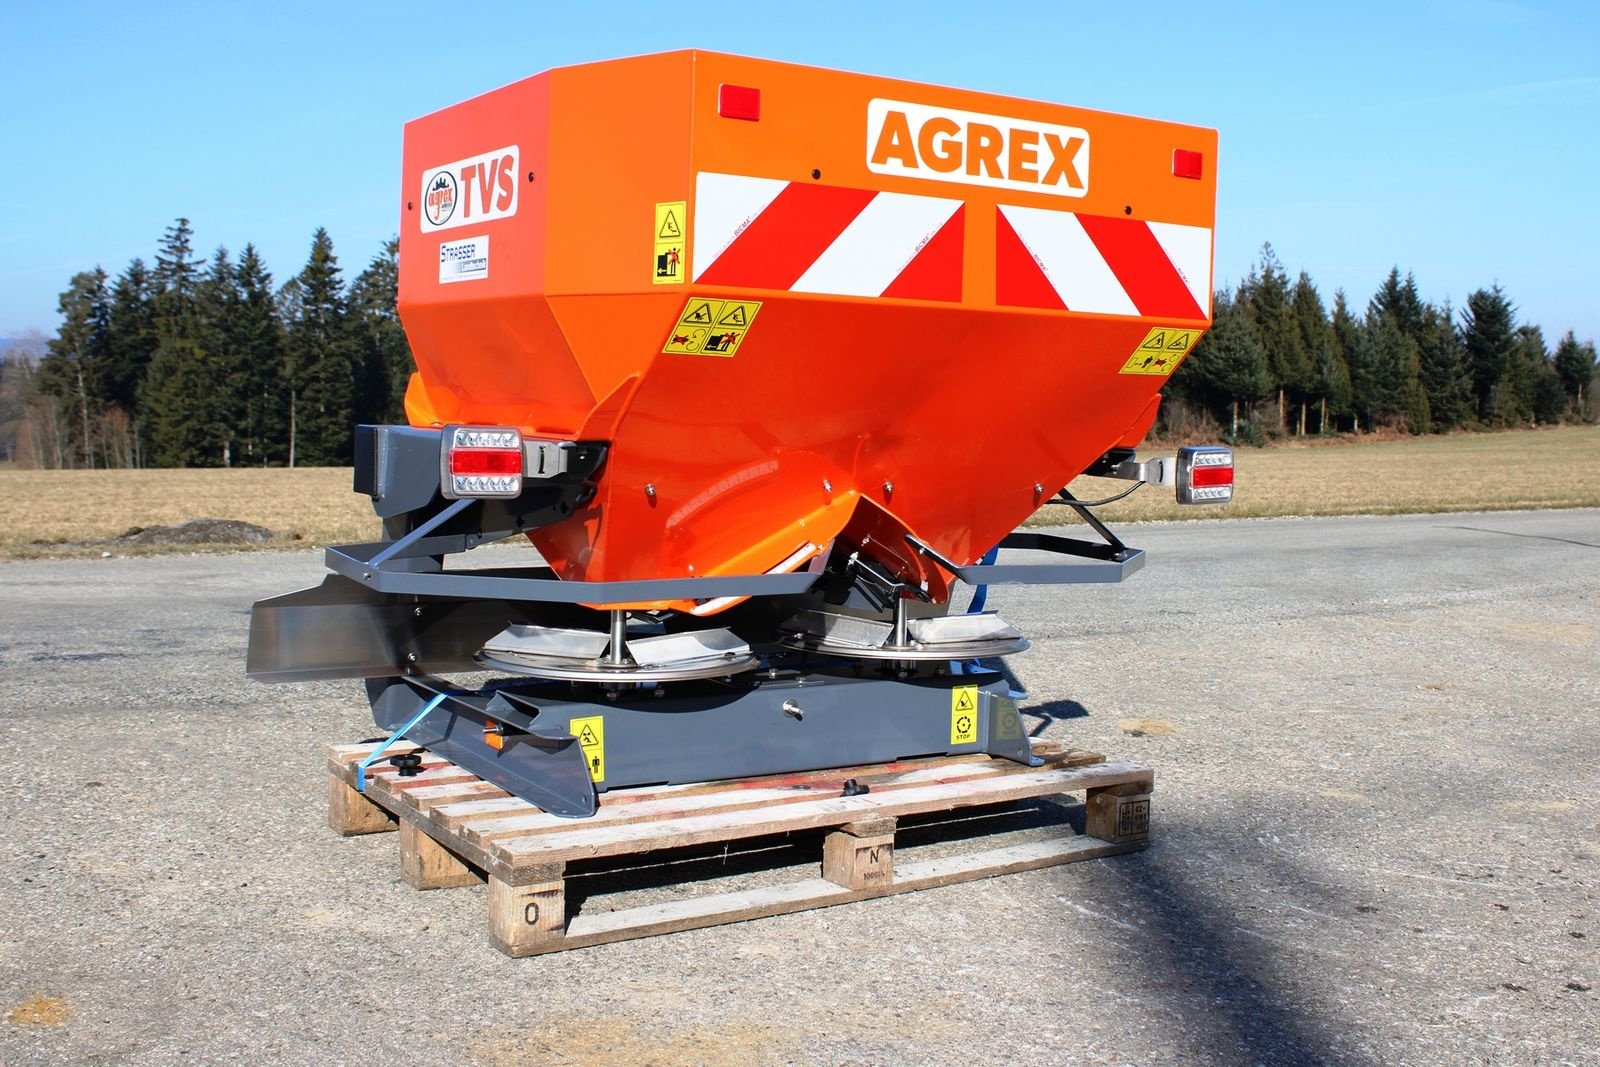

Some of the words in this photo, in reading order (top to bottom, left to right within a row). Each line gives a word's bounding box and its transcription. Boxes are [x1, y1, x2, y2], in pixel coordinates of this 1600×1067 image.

[871, 110, 1085, 189] AGREX
[429, 188, 453, 220] agrex
[461, 155, 514, 218] TVS
[870, 848, 879, 864] N
